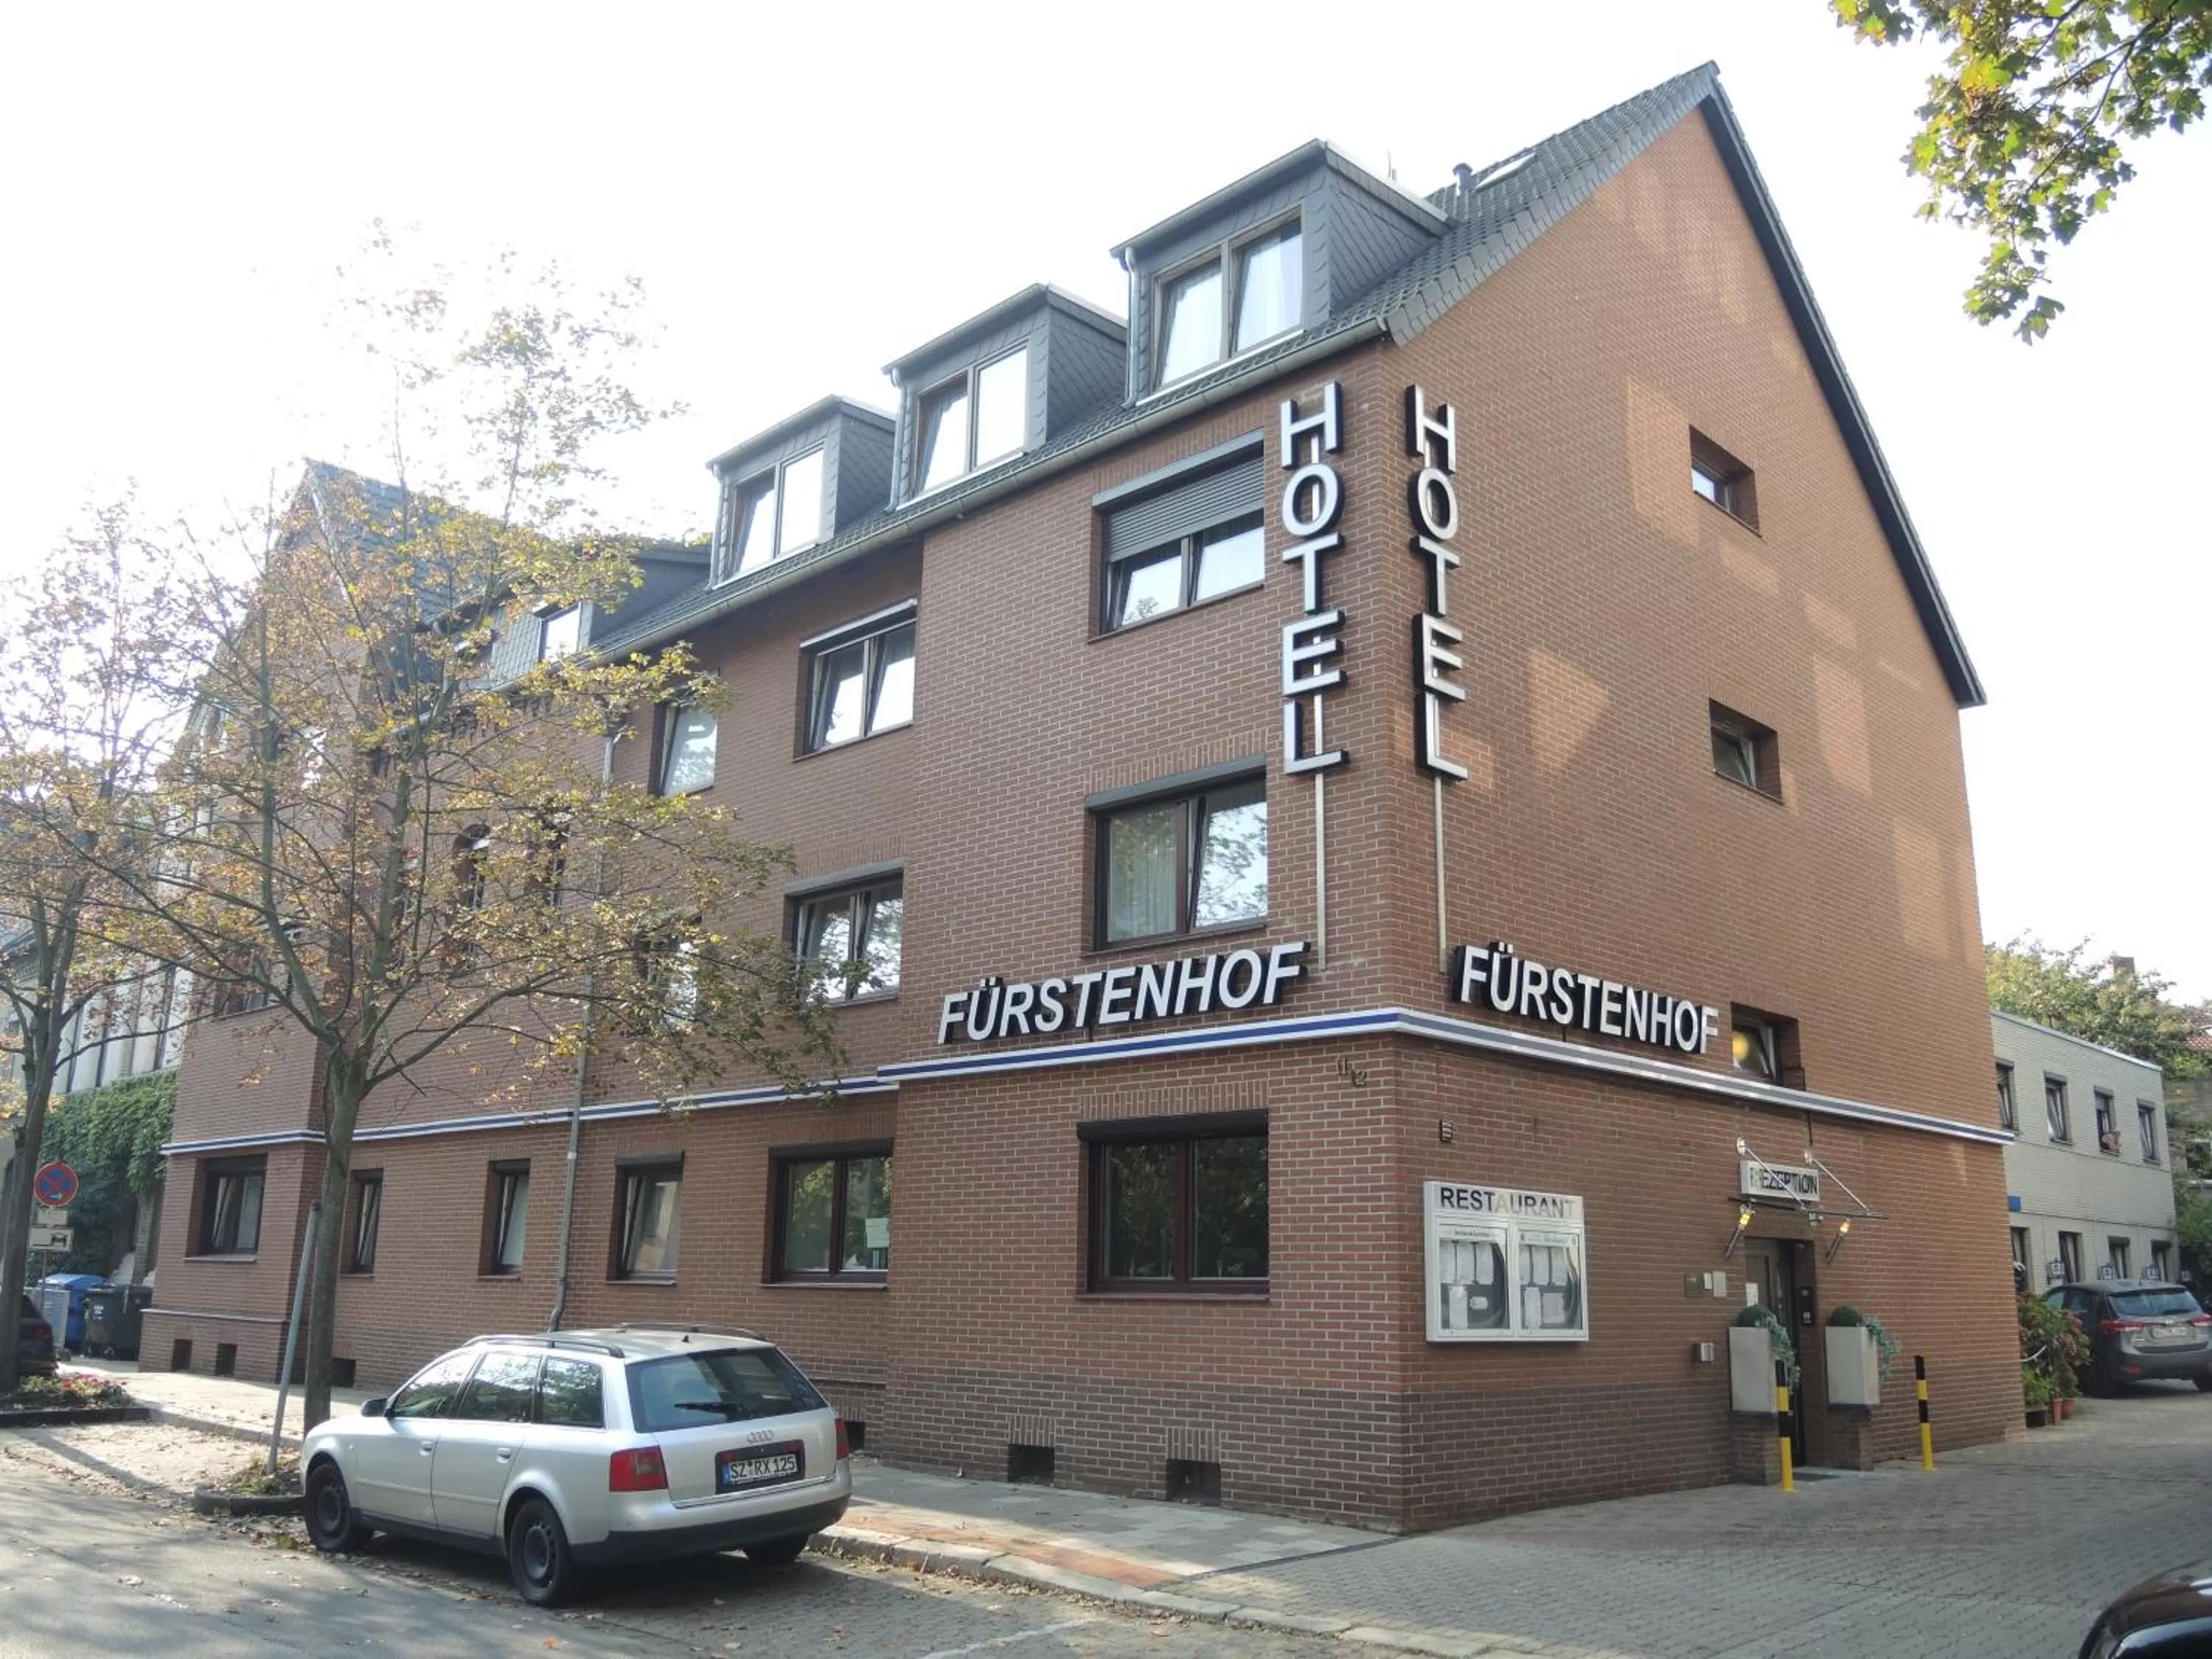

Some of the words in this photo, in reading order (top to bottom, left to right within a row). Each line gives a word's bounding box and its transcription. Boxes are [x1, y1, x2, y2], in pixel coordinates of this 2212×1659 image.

[1281, 380, 1345, 776] HOTEL
[1407, 383, 1469, 780] HOTEL
[937, 942, 1311, 1044] FÜRSTENHOF
[1454, 942, 1719, 1054] FÜRSTENHOF
[1440, 1186, 1576, 1218] RESTAURANT
[731, 1463, 747, 1478] SZ
[754, 1460, 771, 1475] RX
[774, 1456, 796, 1473] 125
